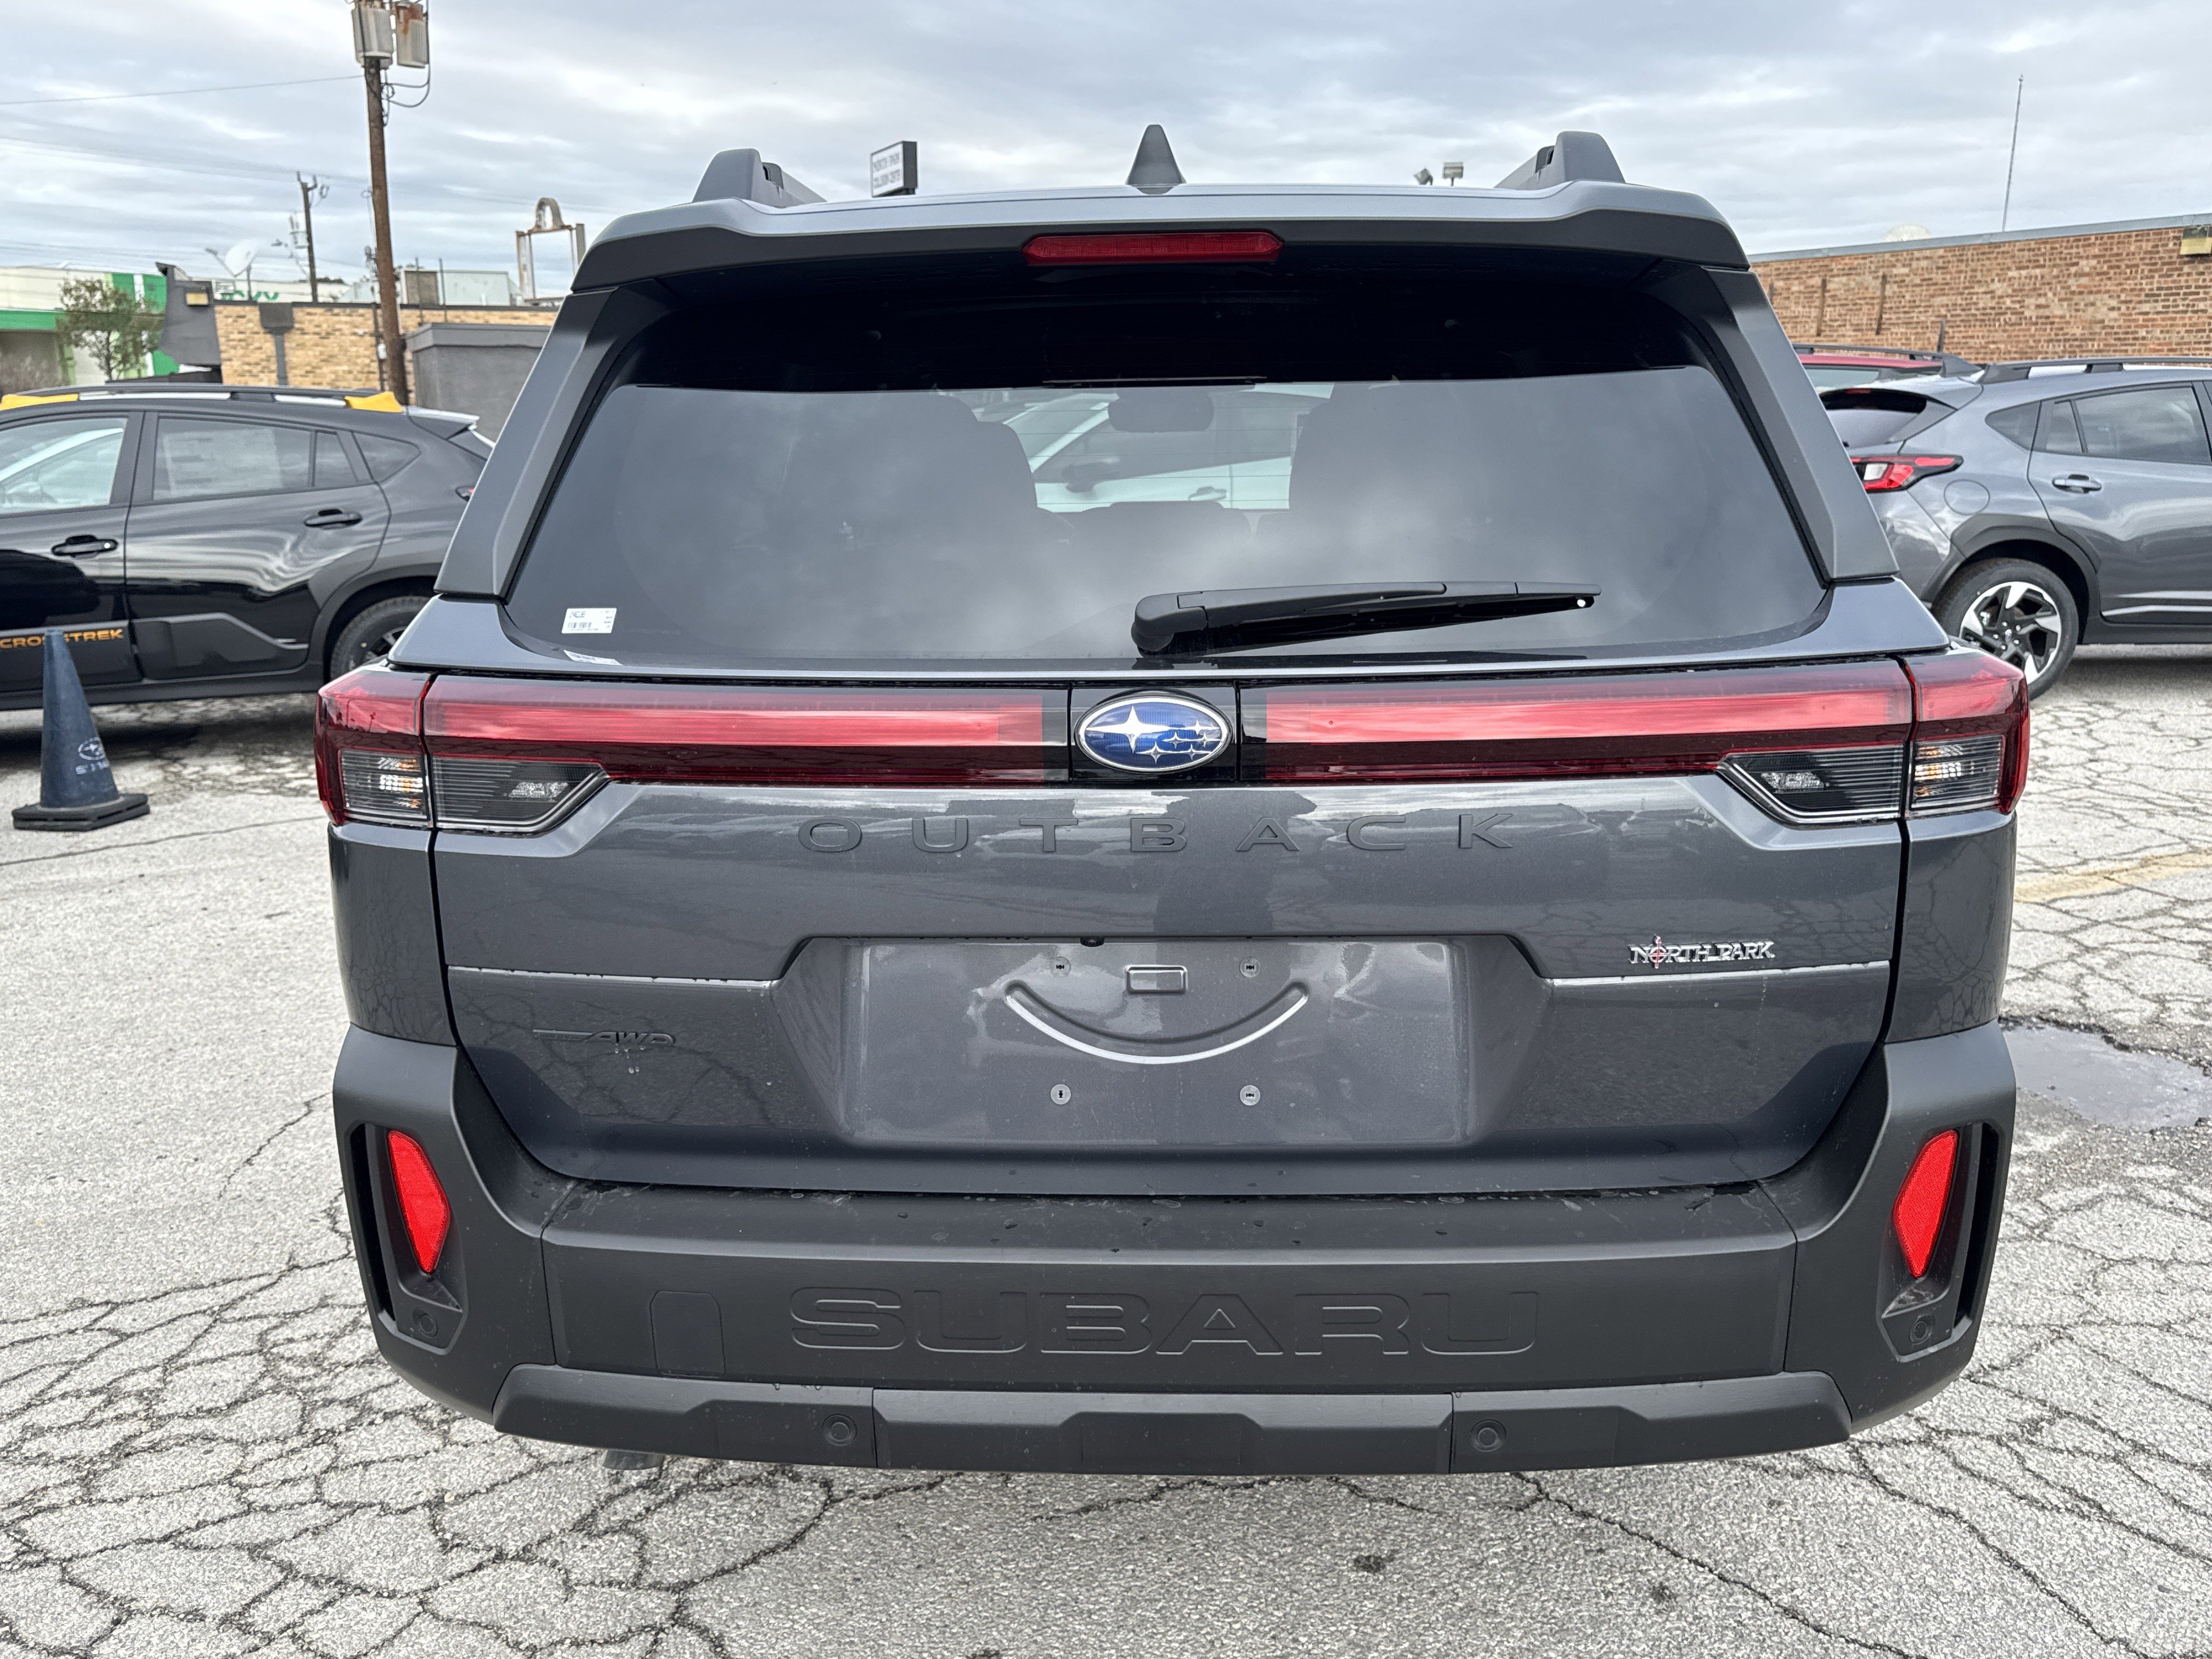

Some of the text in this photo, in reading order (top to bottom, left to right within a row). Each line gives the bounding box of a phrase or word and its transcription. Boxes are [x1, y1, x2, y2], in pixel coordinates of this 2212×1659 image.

[0, 629, 123, 648] CROTREK
[798, 814, 1514, 853] OUTBACK
[1628, 938, 1775, 967] NORTH PARK
[584, 1031, 676, 1045] AWD
[791, 1286, 1538, 1355] SUBARU
